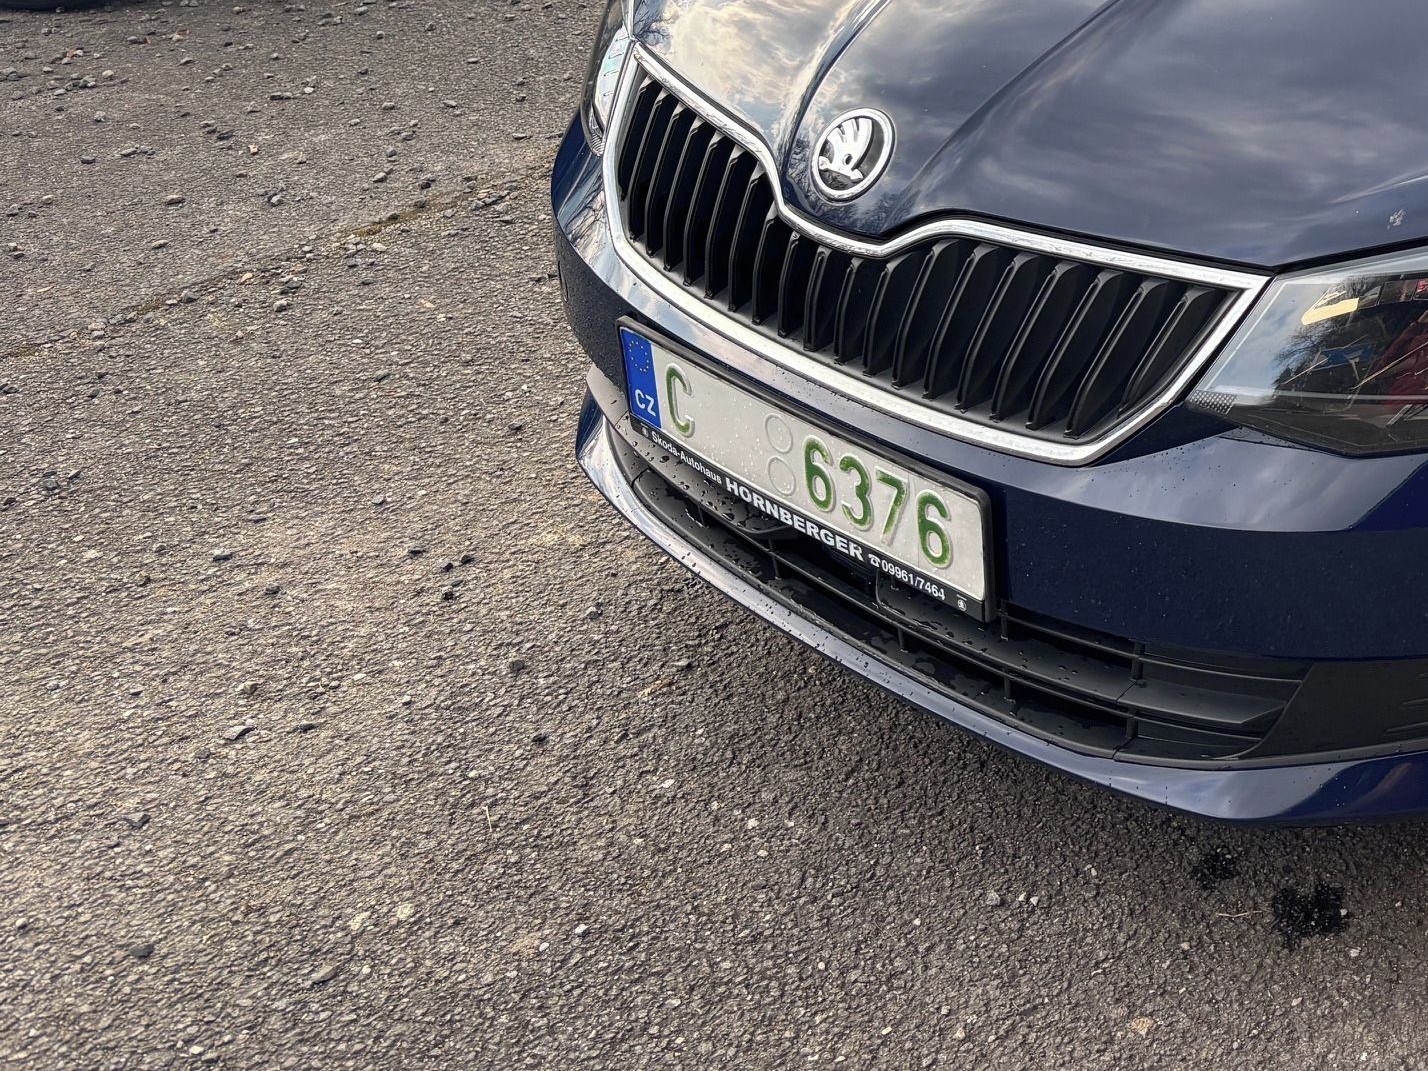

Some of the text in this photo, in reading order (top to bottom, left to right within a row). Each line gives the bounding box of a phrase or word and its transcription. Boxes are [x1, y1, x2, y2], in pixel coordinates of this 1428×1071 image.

[634, 389, 657, 417] CZ
[666, 363, 952, 569] C 6376
[725, 477, 865, 562] HORNBERGER
[881, 562, 946, 601] 09961/7464
